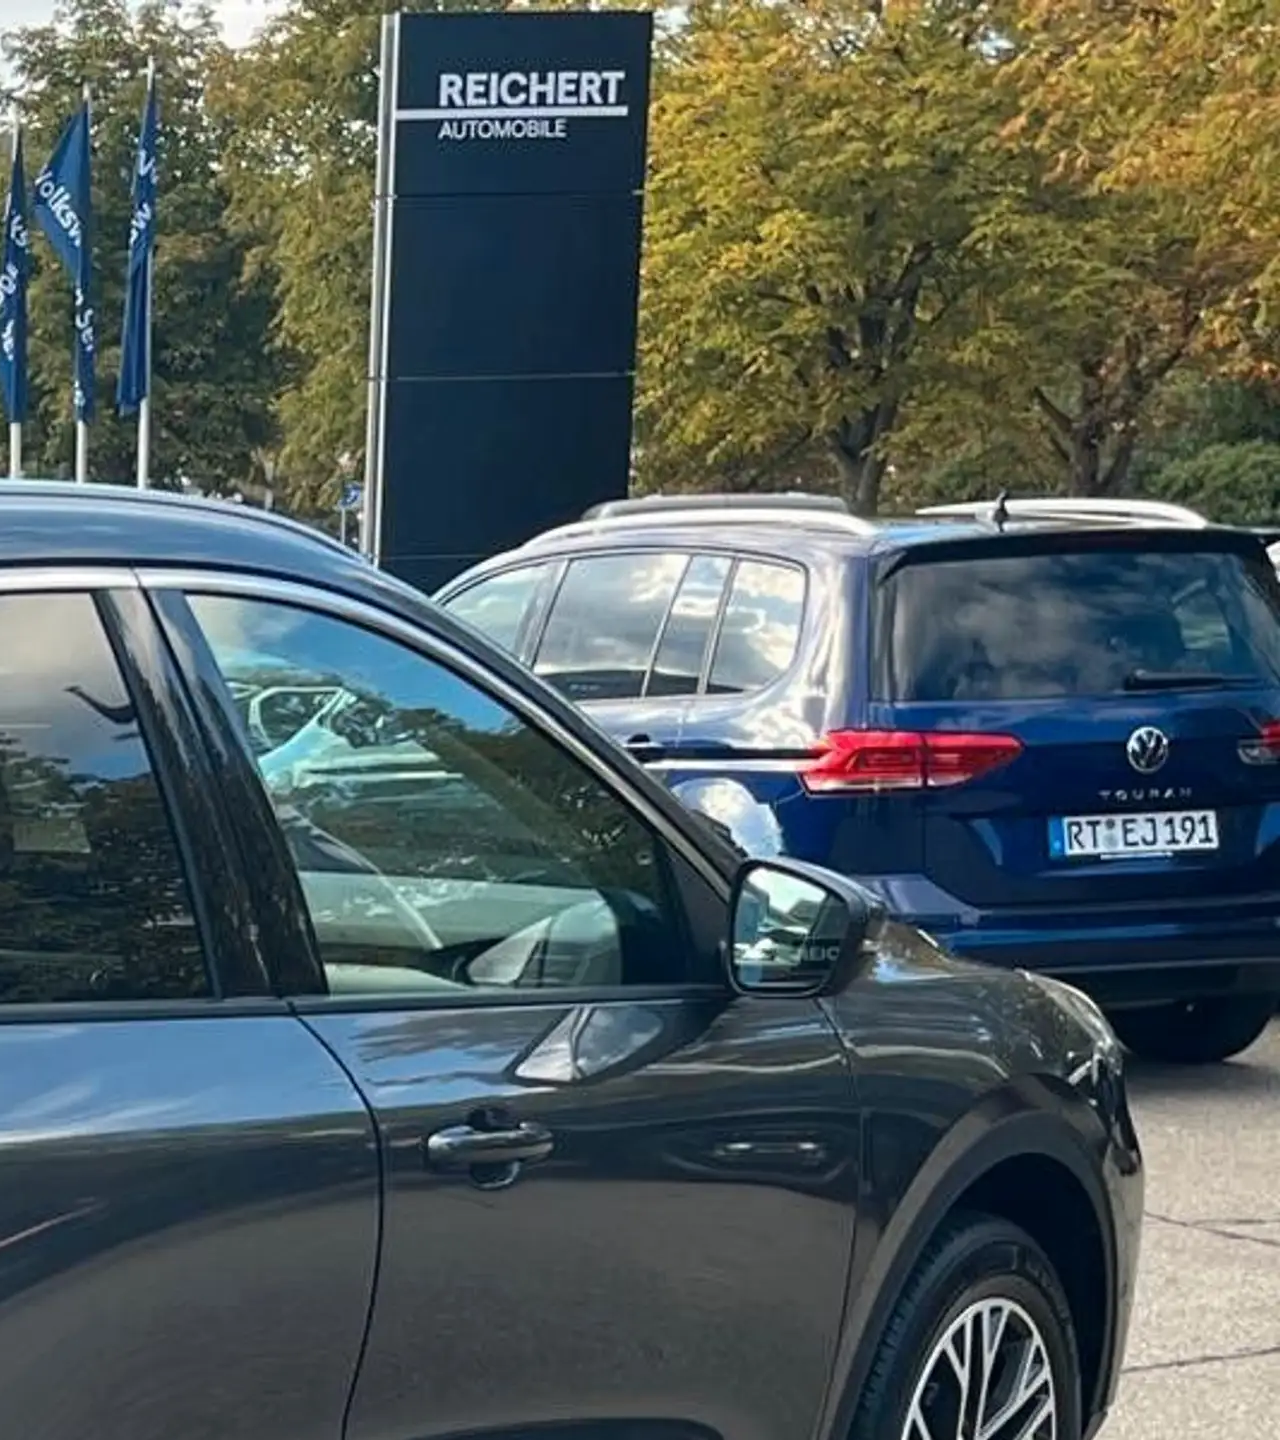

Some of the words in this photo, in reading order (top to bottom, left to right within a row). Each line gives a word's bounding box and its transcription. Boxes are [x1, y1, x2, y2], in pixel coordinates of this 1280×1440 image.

[439, 71, 626, 107] REICHERT
[438, 119, 567, 140] AUTOMOBILE
[1097, 787, 1192, 801] TOURAN
[1066, 820, 1102, 850] RT
[1122, 817, 1158, 847] EJ
[1164, 814, 1214, 846] 191
